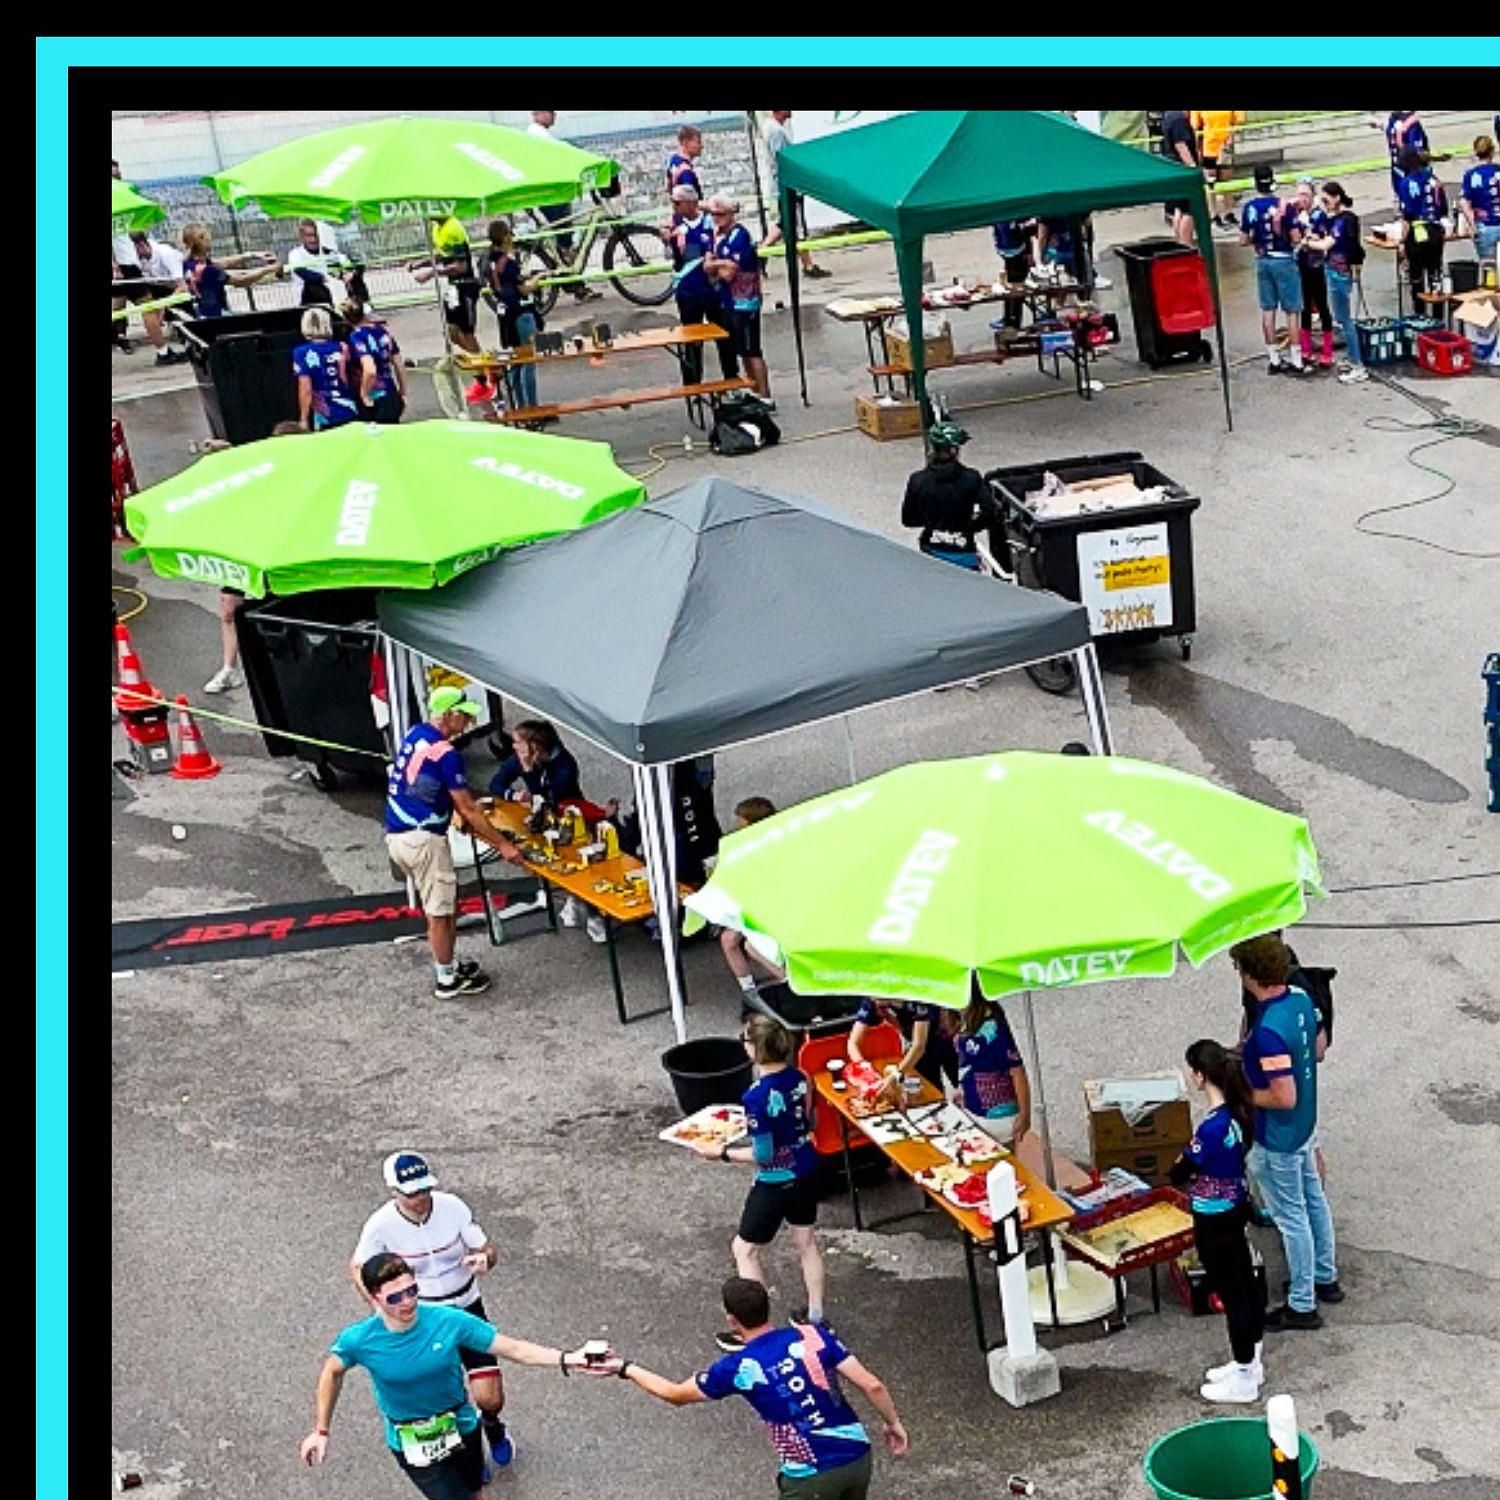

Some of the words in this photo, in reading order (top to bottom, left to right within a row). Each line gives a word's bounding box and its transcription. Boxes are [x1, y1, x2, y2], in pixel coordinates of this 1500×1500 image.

[380, 200, 456, 217] DATEV
[335, 479, 378, 546] DATEV
[867, 829, 960, 945] DATEV
[1082, 810, 1234, 900] DATEV
[1020, 949, 1136, 986] DATEV
[777, 1357, 825, 1427] ROTH
